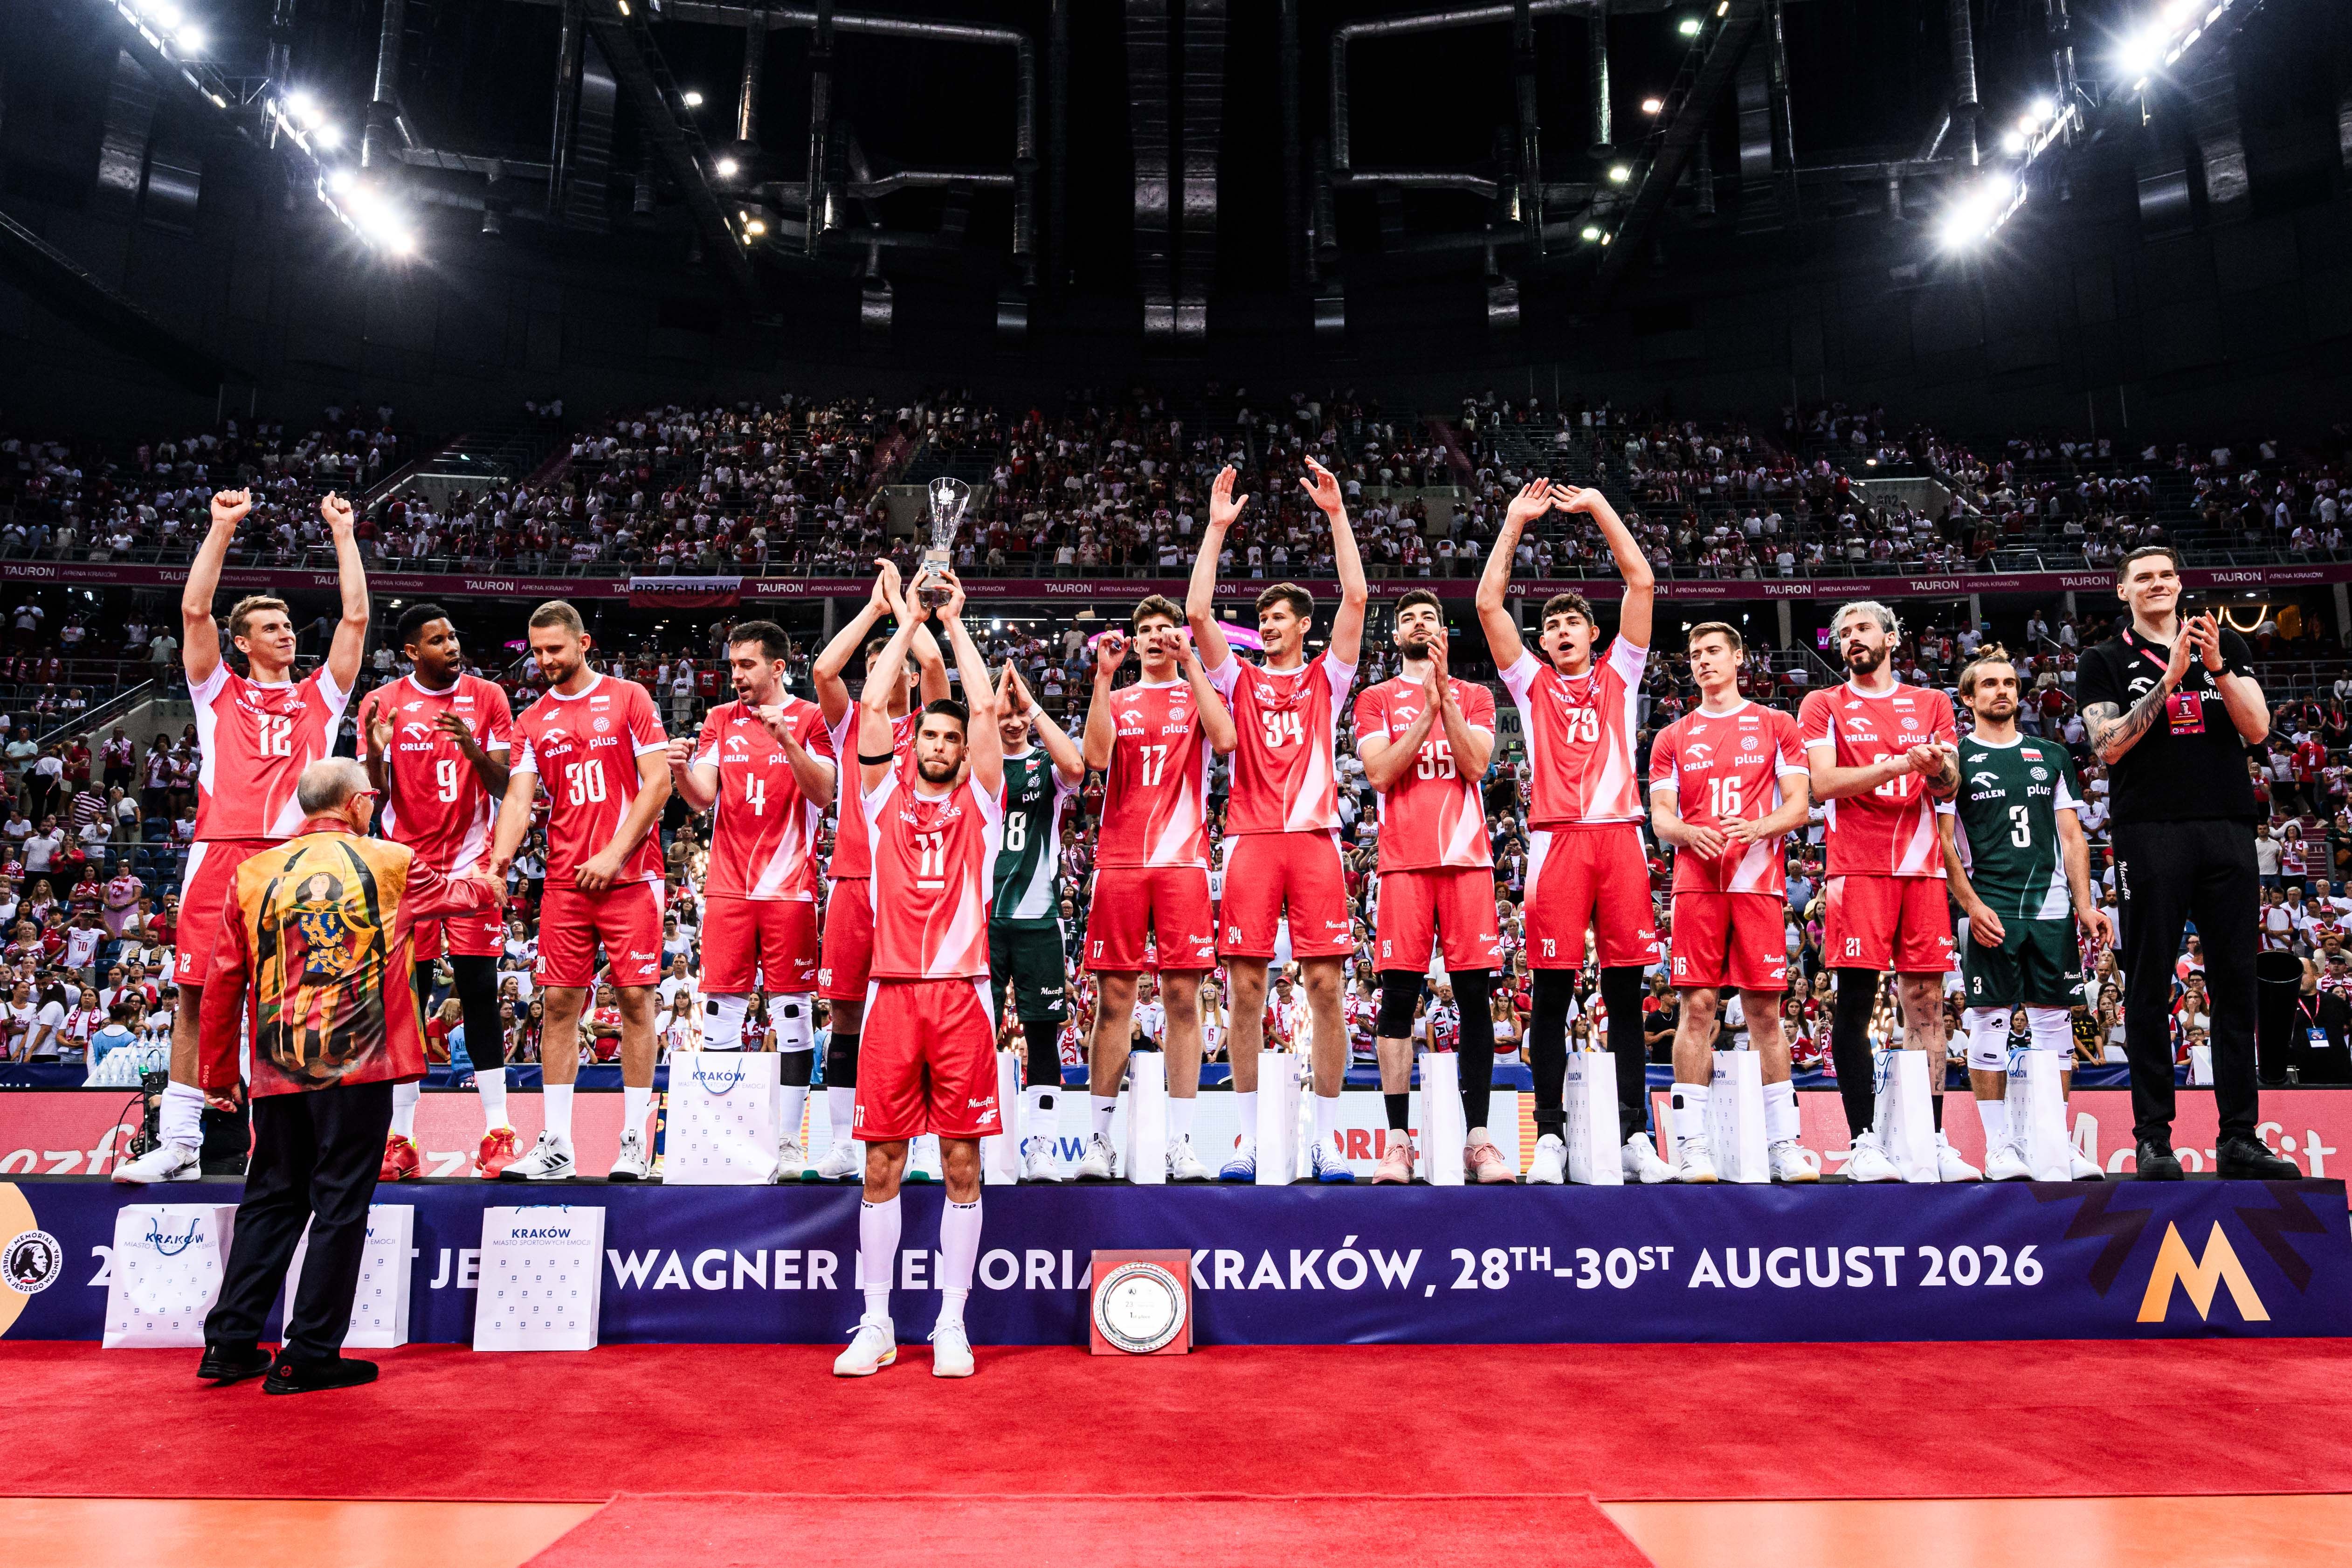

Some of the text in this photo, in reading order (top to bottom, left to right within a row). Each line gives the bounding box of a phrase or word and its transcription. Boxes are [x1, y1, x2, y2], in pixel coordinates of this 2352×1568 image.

[4, 566, 55, 576] TAURON
[2211, 572, 2261, 582] TAURON
[465, 580, 514, 591] TAURON
[756, 583, 803, 592] TAURON
[1045, 583, 1092, 593] TAURON
[1910, 580, 1959, 591] TAURON
[2060, 576, 2110, 587] TAURON
[1763, 584, 1811, 594] TAURON
[1118, 728, 1145, 737] ORLEN
[1162, 723, 1189, 736] plus
[1262, 711, 1304, 747] 34
[1566, 708, 1600, 744] 73
[258, 714, 292, 757] 12
[589, 735, 618, 750] plus
[1898, 732, 1927, 745] plus
[400, 742, 434, 751] ORLEN
[545, 744, 572, 758] ORLEN
[769, 753, 789, 765] plu
[1140, 745, 1167, 786] 17
[1417, 739, 1455, 781] 35
[1683, 759, 1714, 772] ORLEN
[1735, 753, 1765, 767] plus
[436, 760, 457, 802] 9
[565, 759, 607, 806] 30
[746, 773, 766, 815] 4
[1708, 776, 1741, 817] 16
[1971, 789, 2006, 801] ORLEN
[2027, 783, 2051, 797] plus
[2009, 805, 2031, 848] 3
[915, 831, 944, 876] 11
[2117, 860, 2131, 900] Maczfit
[1229, 926, 1242, 944] 34
[78, 941, 87, 952] 10
[1093, 940, 1104, 958] 17
[1382, 939, 1392, 958] 35
[1541, 939, 1556, 957] 73
[1846, 937, 1860, 956] 21
[630, 950, 655, 960] Maczfit
[178, 953, 192, 973] 12
[1673, 957, 1686, 975] 16
[1041, 987, 1063, 996] Maczfit
[1973, 976, 1982, 995] 3
[692, 1069, 746, 1081] KRAKÓW
[968, 1096, 994, 1109] Maczfit
[854, 1105, 865, 1127] 11
[14, 1232, 53, 1246] MEMORIAŁ
[511, 1225, 571, 1239] KRAKÓW
[566, 1238, 592, 1247] EMOCJI
[3, 1248, 12, 1282] HUBERTA
[11, 1282, 44, 1292] JERZEGO
[44, 1249, 60, 1283] WAGNERA
[607, 1249, 838, 1290] WAGNER
[1688, 1245, 1905, 1288] AUGUST
[1918, 1244, 2044, 1287] 2026
